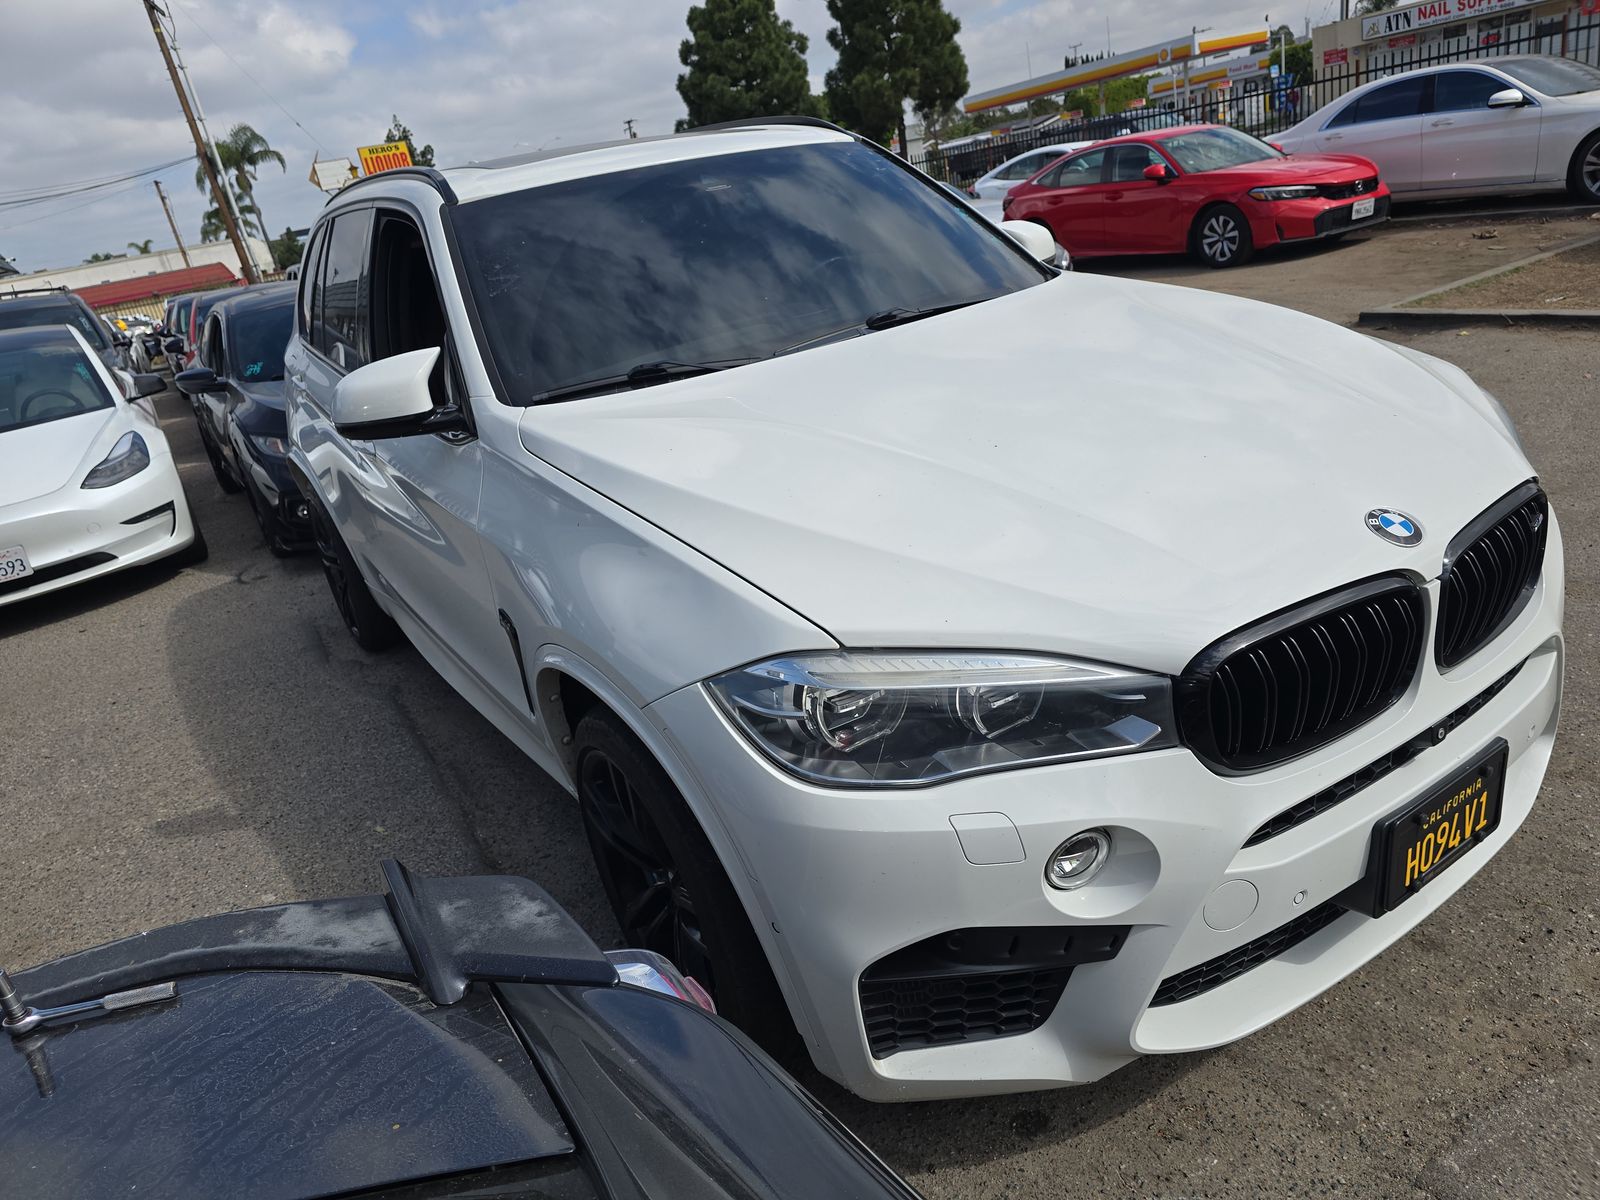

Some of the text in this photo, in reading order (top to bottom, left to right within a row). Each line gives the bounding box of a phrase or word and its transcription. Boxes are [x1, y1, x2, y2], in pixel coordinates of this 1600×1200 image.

[1384, 11, 1411, 33] ATN
[1418, 1, 1451, 20] NAIL
[368, 144, 400, 155] HERO'S
[364, 152, 410, 175] LIQUOR
